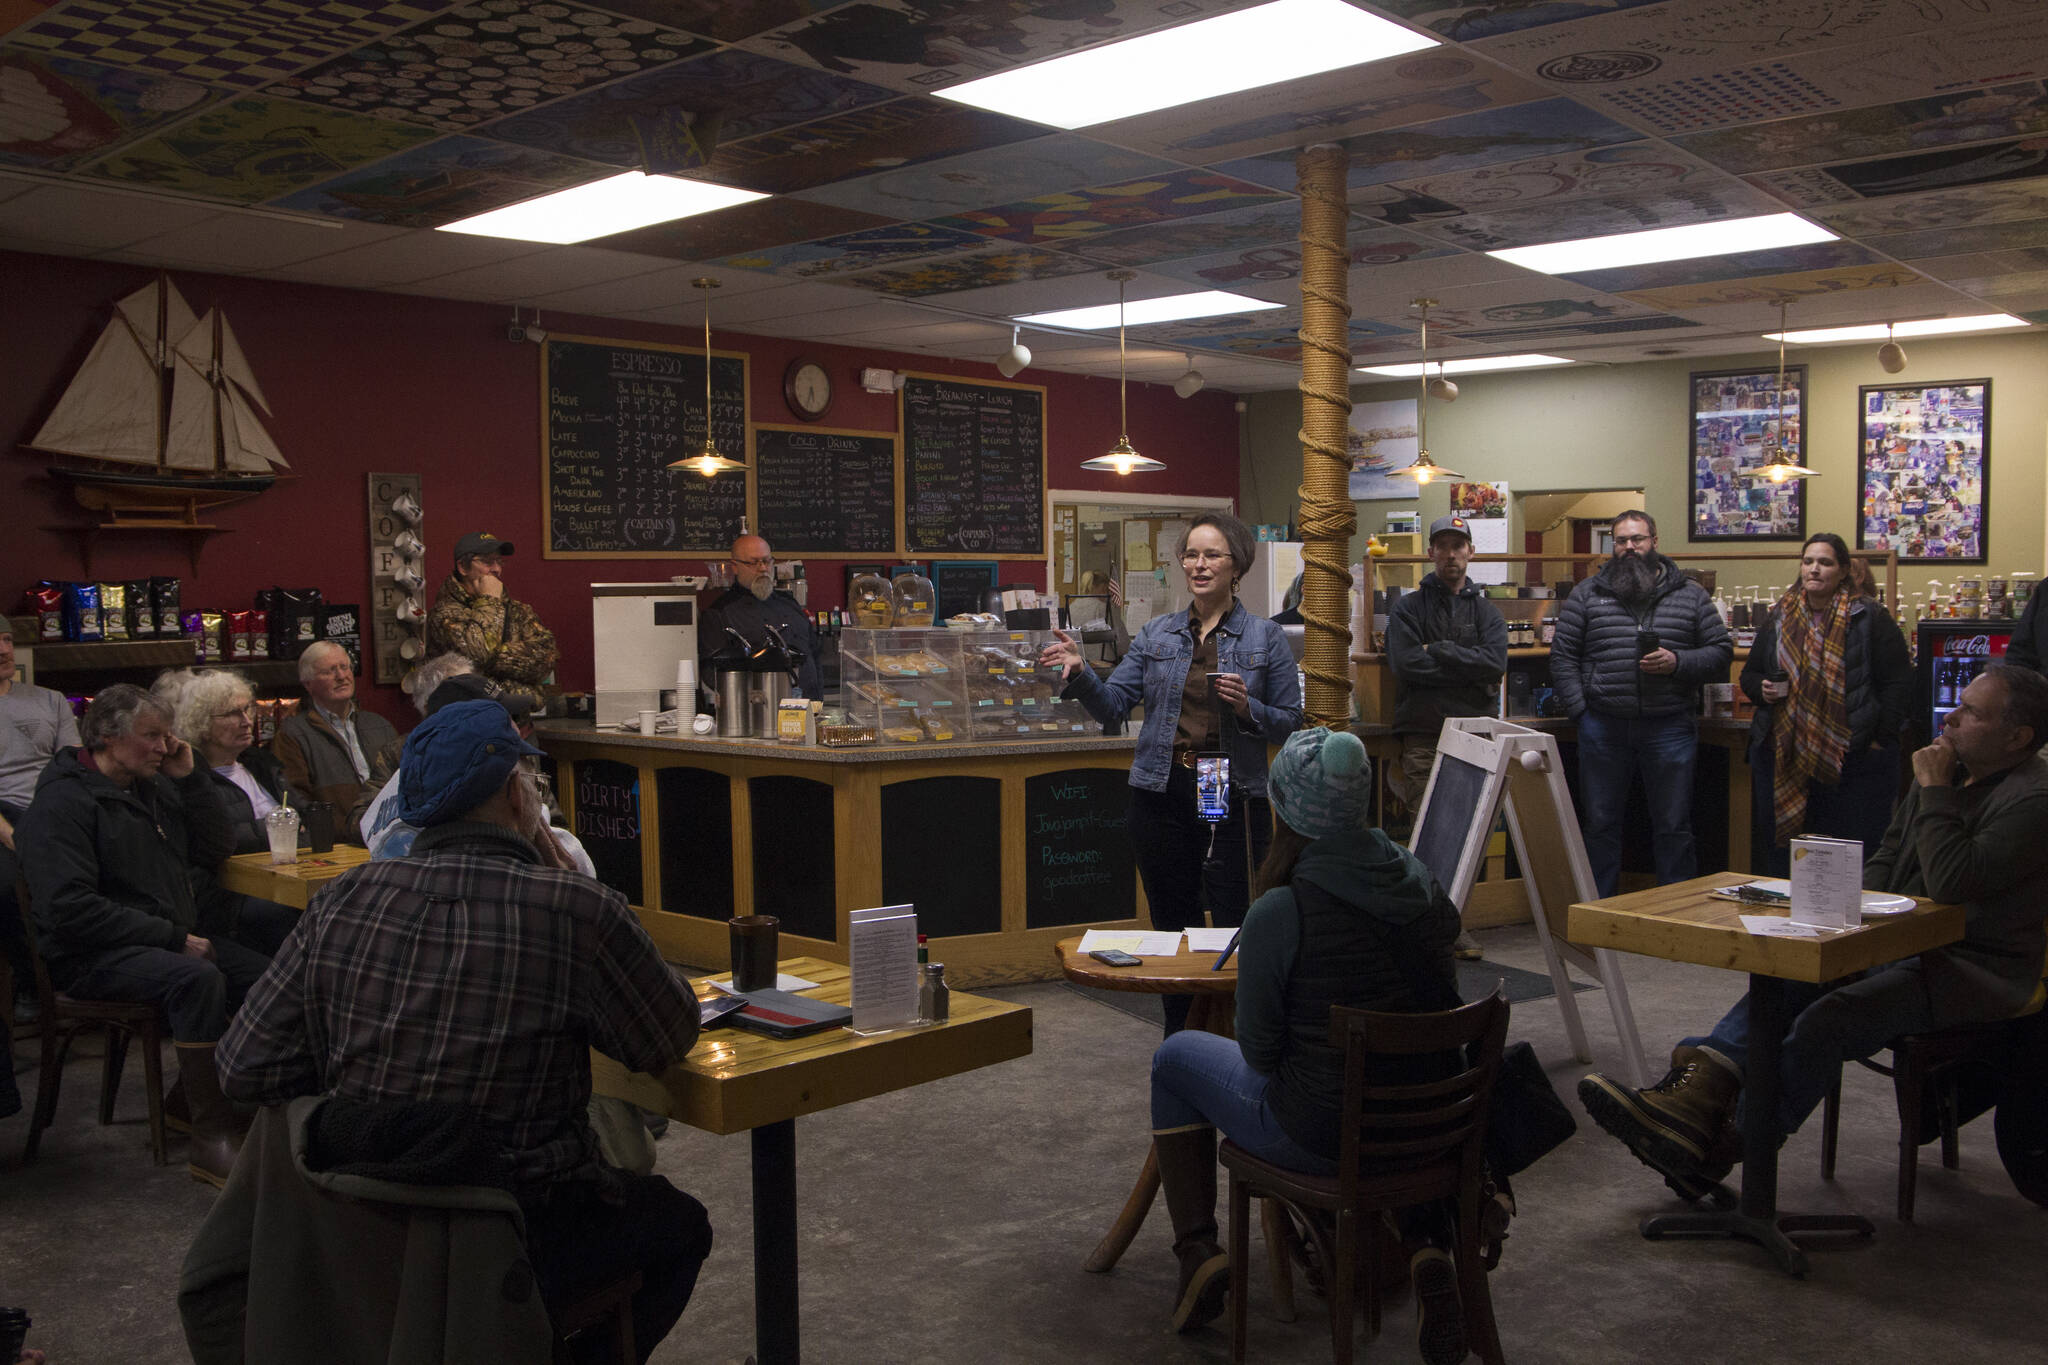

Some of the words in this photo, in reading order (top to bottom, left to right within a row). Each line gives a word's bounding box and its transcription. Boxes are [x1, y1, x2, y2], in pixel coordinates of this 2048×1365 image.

[612, 352, 682, 374] ESPRESSO
[552, 387, 583, 406] BREVE
[552, 408, 582, 424] MOCHA
[552, 426, 577, 443] LATTE
[788, 433, 816, 447] COLD
[827, 436, 862, 450] DRINKS
[552, 486, 603, 499] AMERICANO
[553, 499, 582, 513] HOUSE
[584, 501, 613, 514] COFFEE
[581, 783, 632, 813] DIRTY
[576, 810, 638, 840] DISHES
